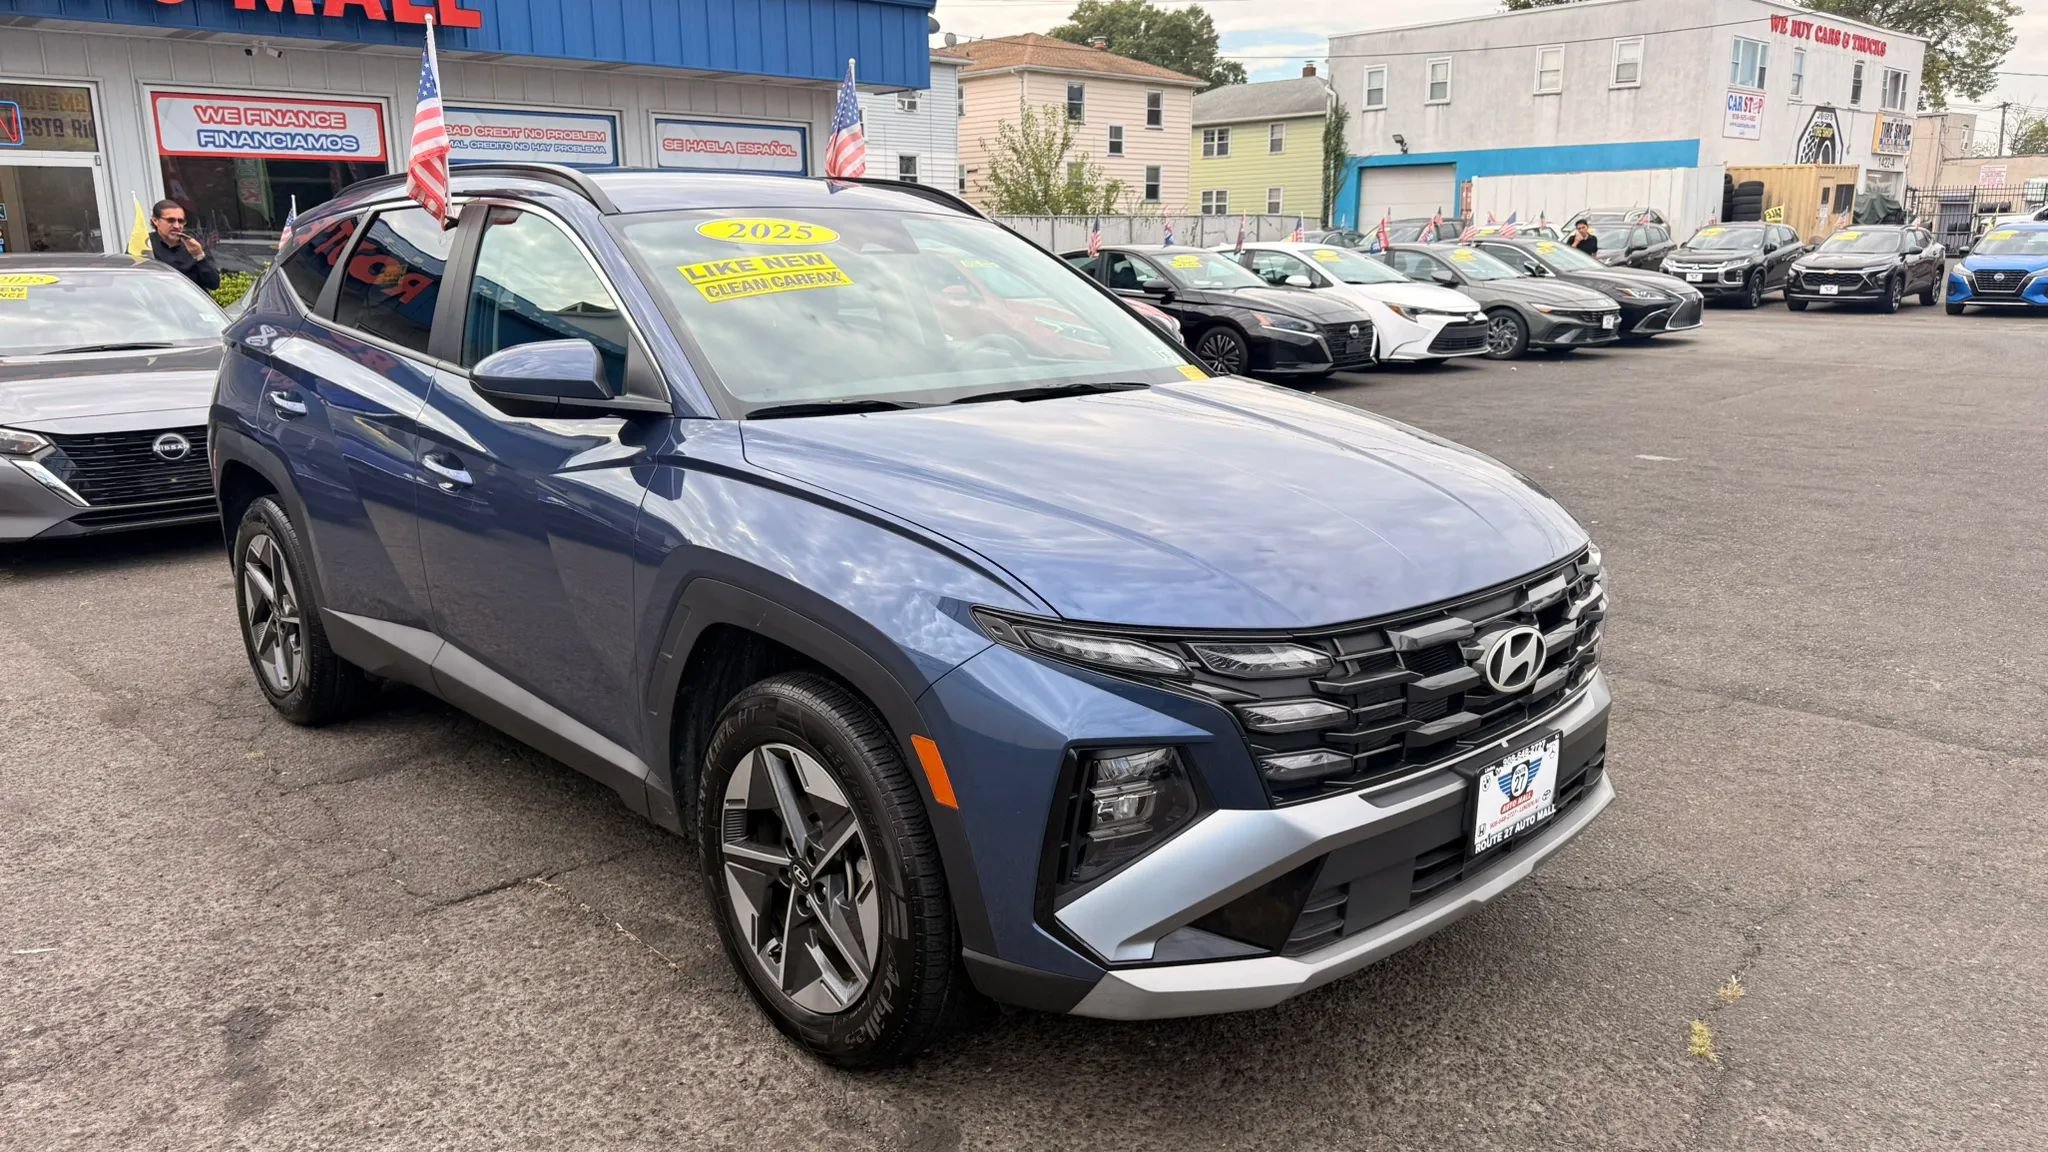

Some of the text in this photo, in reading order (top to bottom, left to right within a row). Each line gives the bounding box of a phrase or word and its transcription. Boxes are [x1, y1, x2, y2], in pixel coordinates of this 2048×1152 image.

[1771, 14, 1788, 34] WE
[1790, 20, 1814, 40] BUY
[1815, 25, 1841, 46] CARS
[1852, 34, 1887, 57] TRUCKS
[1728, 94, 1743, 112] CAR
[194, 106, 346, 129] WE FINANCE
[198, 130, 358, 151] FINANCIAMOS
[446, 125, 606, 141] BAD CREDIT NO PROBLEM
[469, 141, 512, 149] CREDITO
[514, 142, 529, 151] NO
[531, 143, 551, 152] HAY
[554, 144, 607, 154] PROBLEMA
[663, 138, 797, 156] SE HABLA ESPAÑOL
[727, 223, 813, 240] 2025
[685, 253, 826, 281] LIKE NEW
[705, 271, 841, 298] CLEAN CARFAX
[1514, 773, 1526, 793] 27
[1475, 832, 1503, 854] ROUTE
[1503, 825, 1514, 839] 27
[1514, 816, 1535, 834] AUTO
[1537, 804, 1557, 822] MALL
